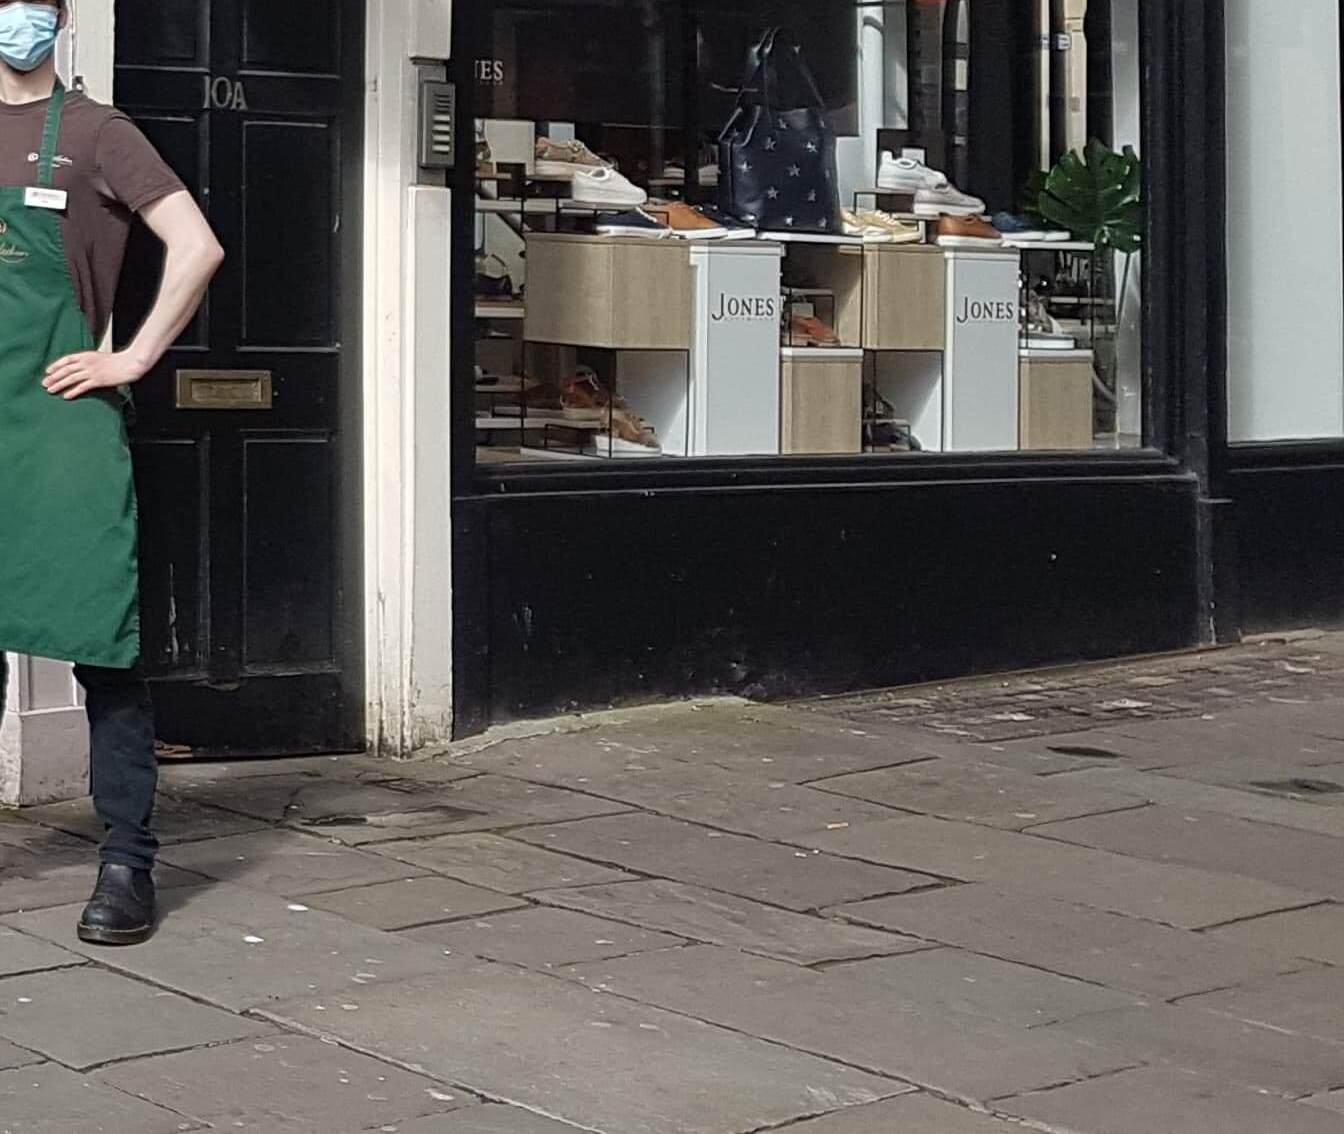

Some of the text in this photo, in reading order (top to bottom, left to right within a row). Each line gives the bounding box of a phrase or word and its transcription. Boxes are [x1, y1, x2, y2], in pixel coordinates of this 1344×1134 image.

[202, 75, 248, 111] 10A
[711, 292, 775, 321] JONES
[956, 296, 1014, 323] JONES
